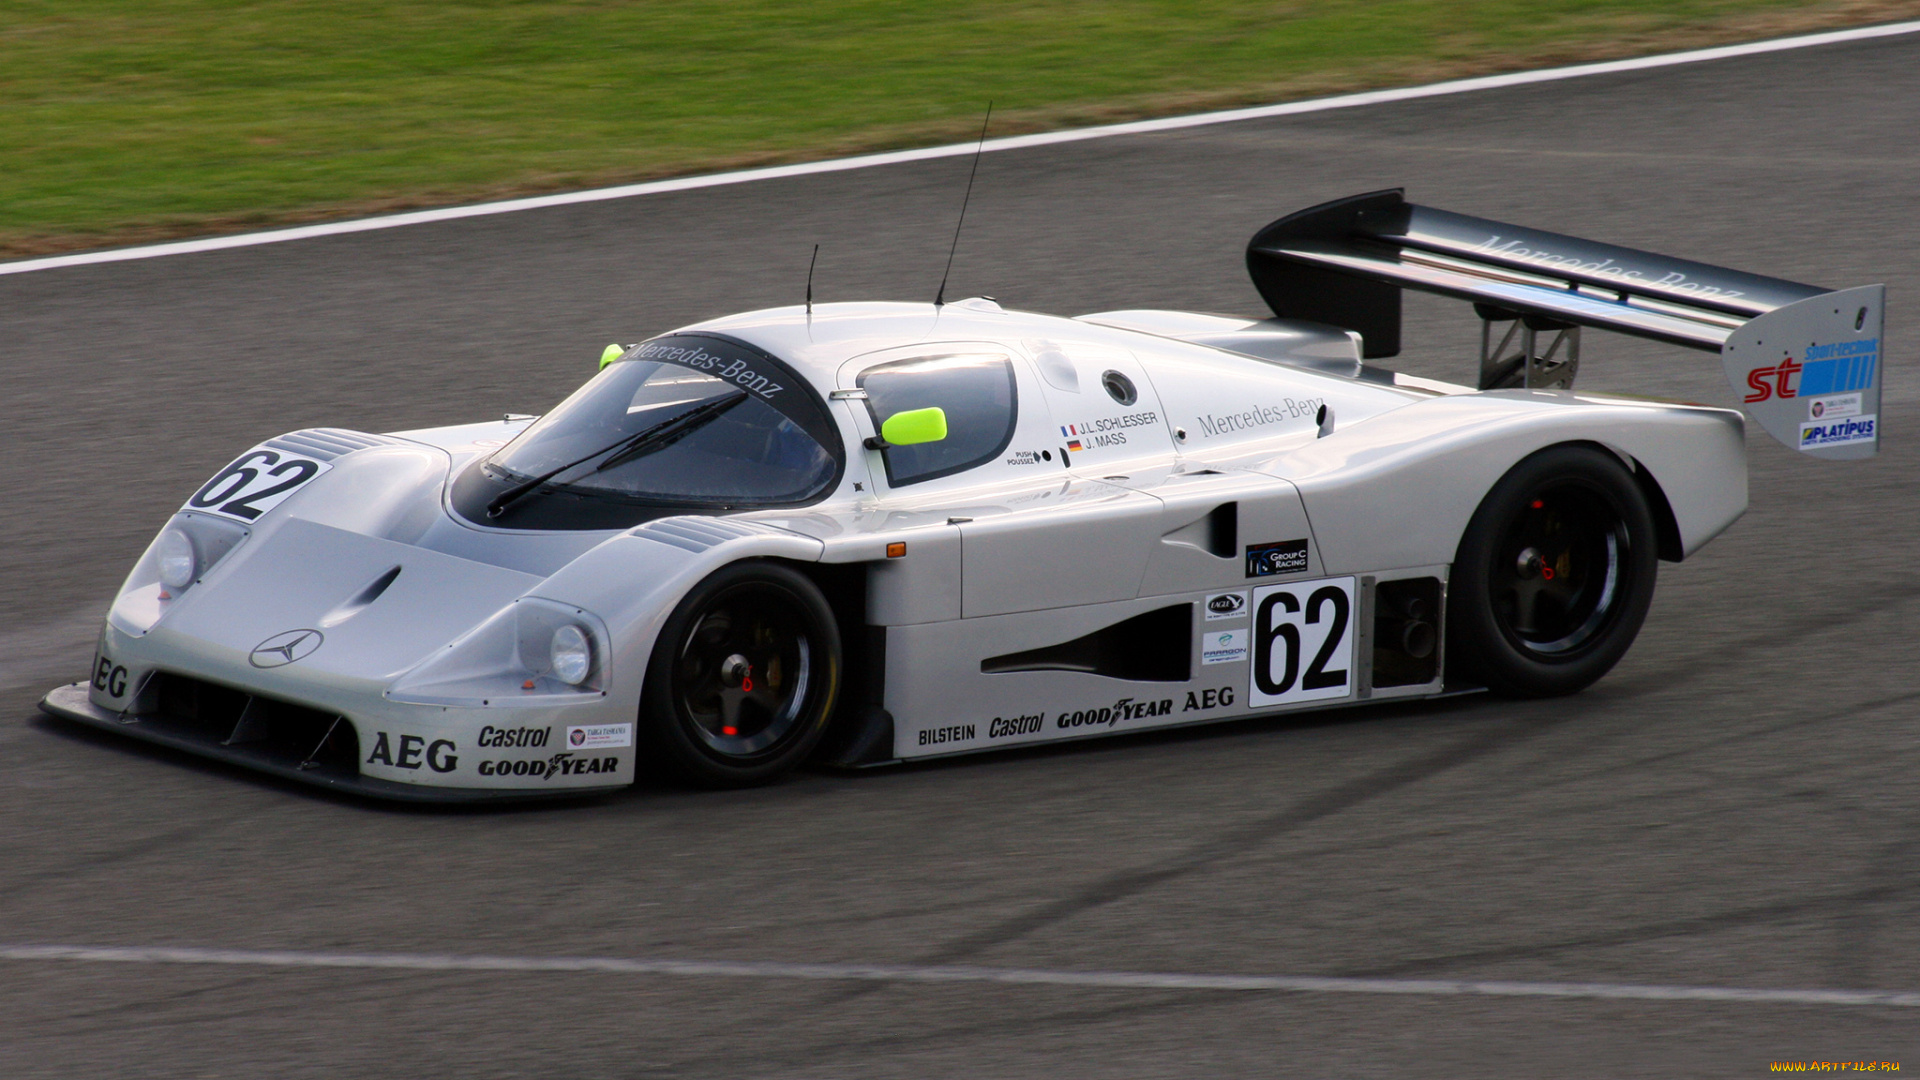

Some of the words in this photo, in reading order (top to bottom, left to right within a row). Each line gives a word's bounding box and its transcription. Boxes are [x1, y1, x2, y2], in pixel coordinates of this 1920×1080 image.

[623, 342, 784, 399] Mercedes-Benz
[1744, 357, 1802, 403] st
[1095, 432, 1127, 447] MASS
[1006, 457, 1035, 465] POUSSEZ
[1015, 450, 1033, 458] PUSH
[189, 450, 319, 520] 62
[1270, 551, 1298, 561] GROUP
[1298, 549, 1307, 558] C
[1275, 558, 1306, 569] RACING
[1254, 585, 1350, 696] 62
[1203, 648, 1247, 657] PARAGON
[918, 724, 975, 745] BILSTEIN
[988, 712, 1045, 739] Castrol
[1182, 686, 1235, 712] AEG
[478, 725, 552, 748] Castrol
[366, 731, 458, 773] AEG
